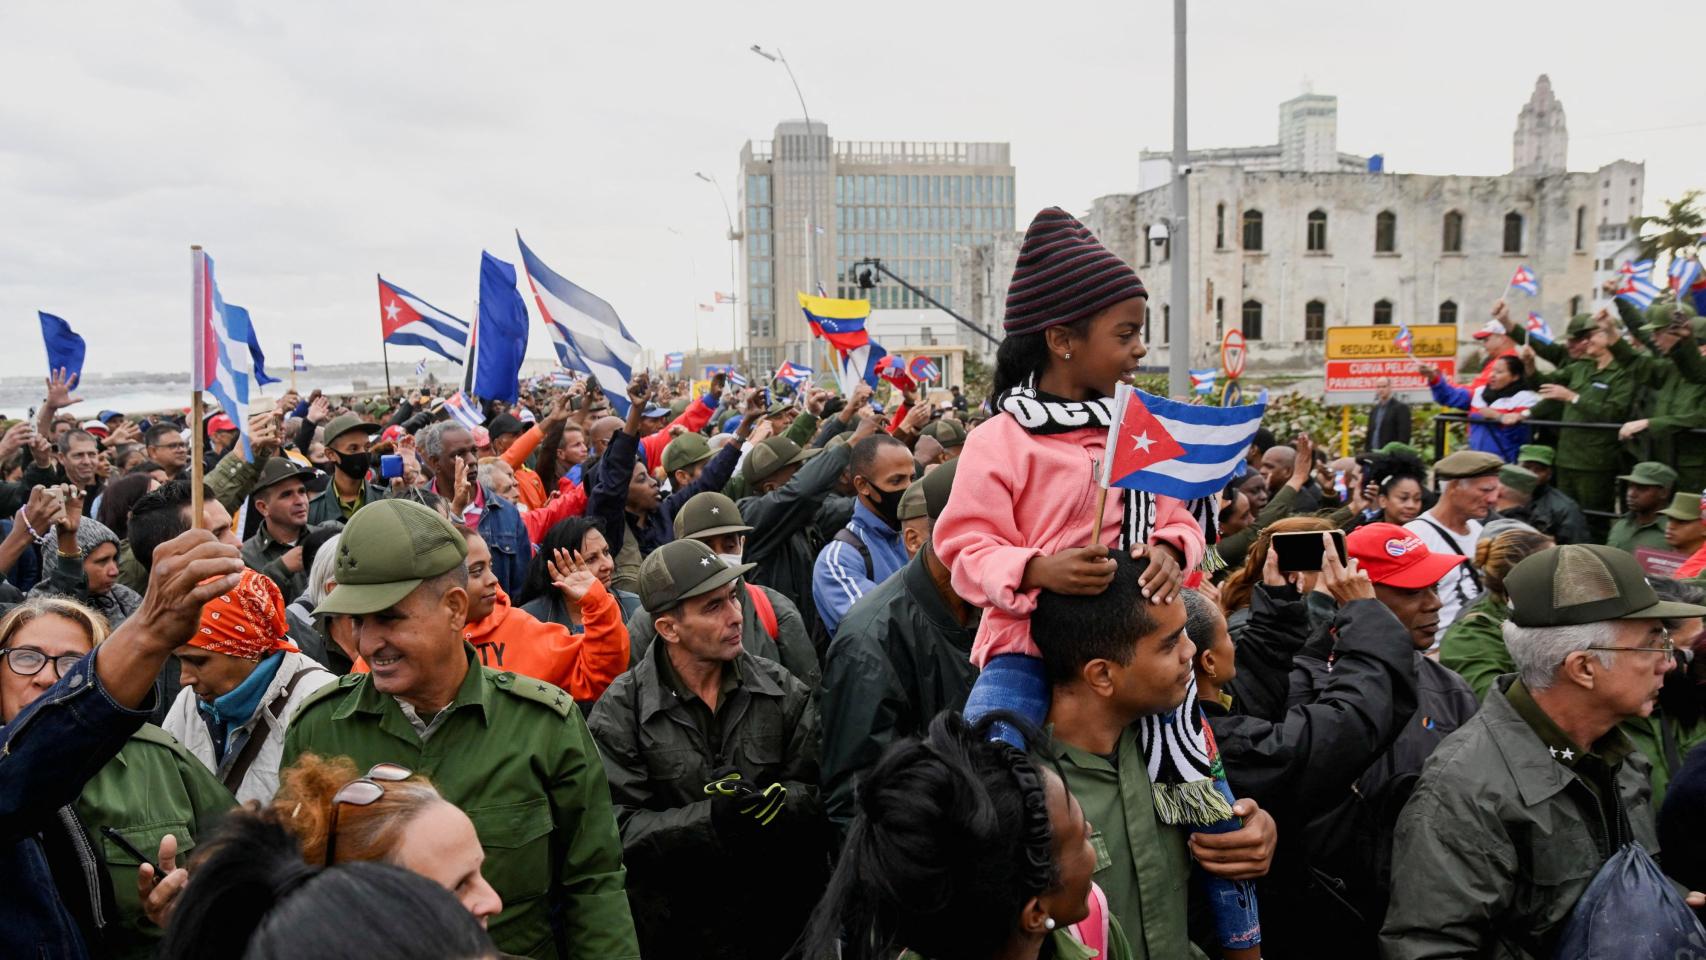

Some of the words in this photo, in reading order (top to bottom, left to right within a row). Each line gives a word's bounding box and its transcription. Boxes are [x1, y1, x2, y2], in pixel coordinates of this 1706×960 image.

[1371, 330, 1414, 341] PELIO
[1340, 344, 1386, 355] REDUZCA
[1388, 342, 1443, 354] VECIDAD
[1349, 362, 1382, 374] CURVA
[1328, 376, 1379, 388] PAVIMENT
